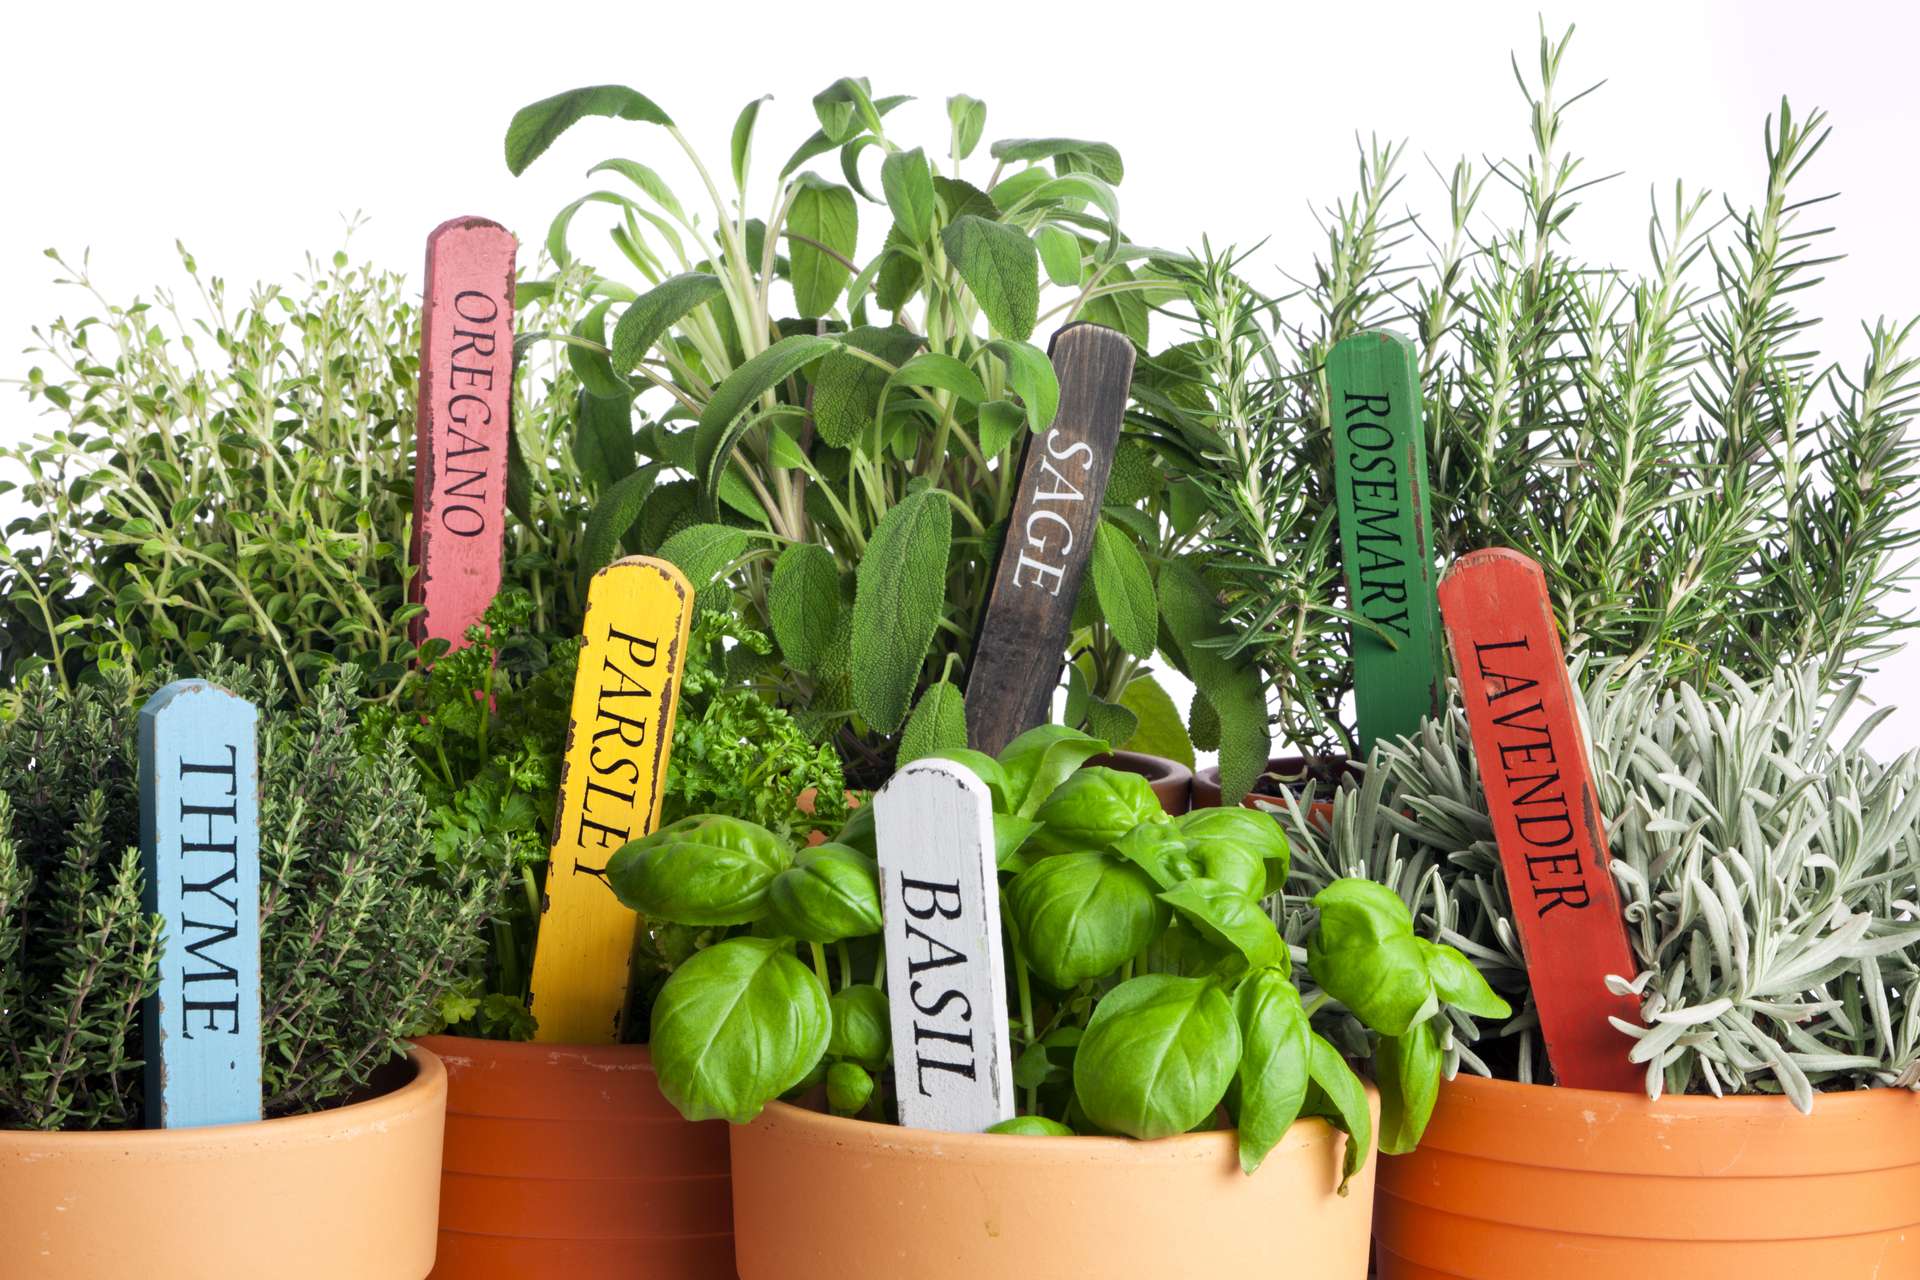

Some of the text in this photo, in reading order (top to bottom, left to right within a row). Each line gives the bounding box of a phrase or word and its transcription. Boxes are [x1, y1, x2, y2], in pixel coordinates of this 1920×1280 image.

[441, 289, 498, 538] OREGANO
[1012, 428, 1094, 597] SAGE
[1343, 390, 1411, 638] ROSEMARY
[179, 744, 240, 1040] THYME
[1472, 635, 1591, 920] LAVENDER
[900, 870, 977, 1097] BASIL
